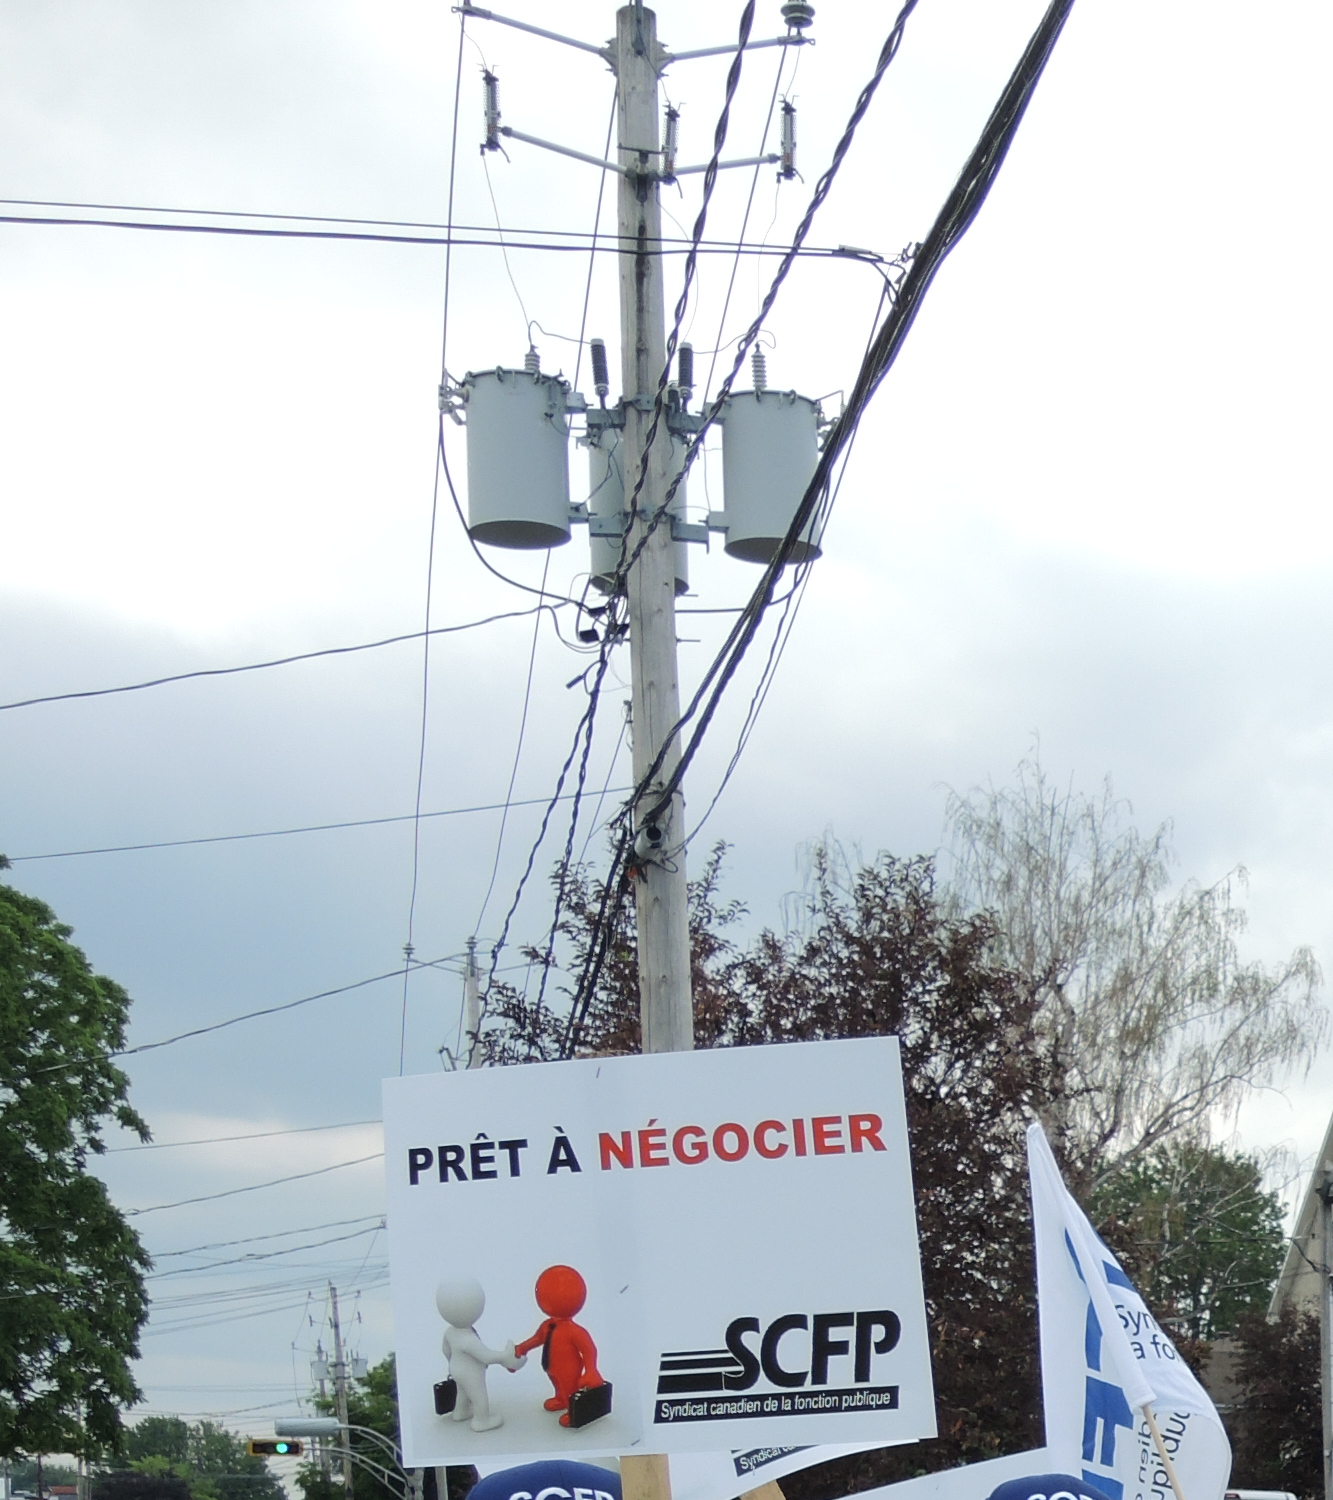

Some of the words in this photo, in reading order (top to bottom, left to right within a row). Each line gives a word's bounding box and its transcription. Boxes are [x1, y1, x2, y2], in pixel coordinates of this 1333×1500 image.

[408, 1133, 528, 1186] PRÊT
[547, 1126, 582, 1175] À
[599, 1113, 887, 1171] NÉGOCIER
[723, 1310, 902, 1392] SCFP
[660, 1401, 708, 1421] Syndicat
[710, 1396, 761, 1417] canadien
[764, 1396, 778, 1412] de
[781, 1395, 792, 1411] la
[794, 1391, 839, 1411] fonction
[841, 1389, 891, 1411] publique
